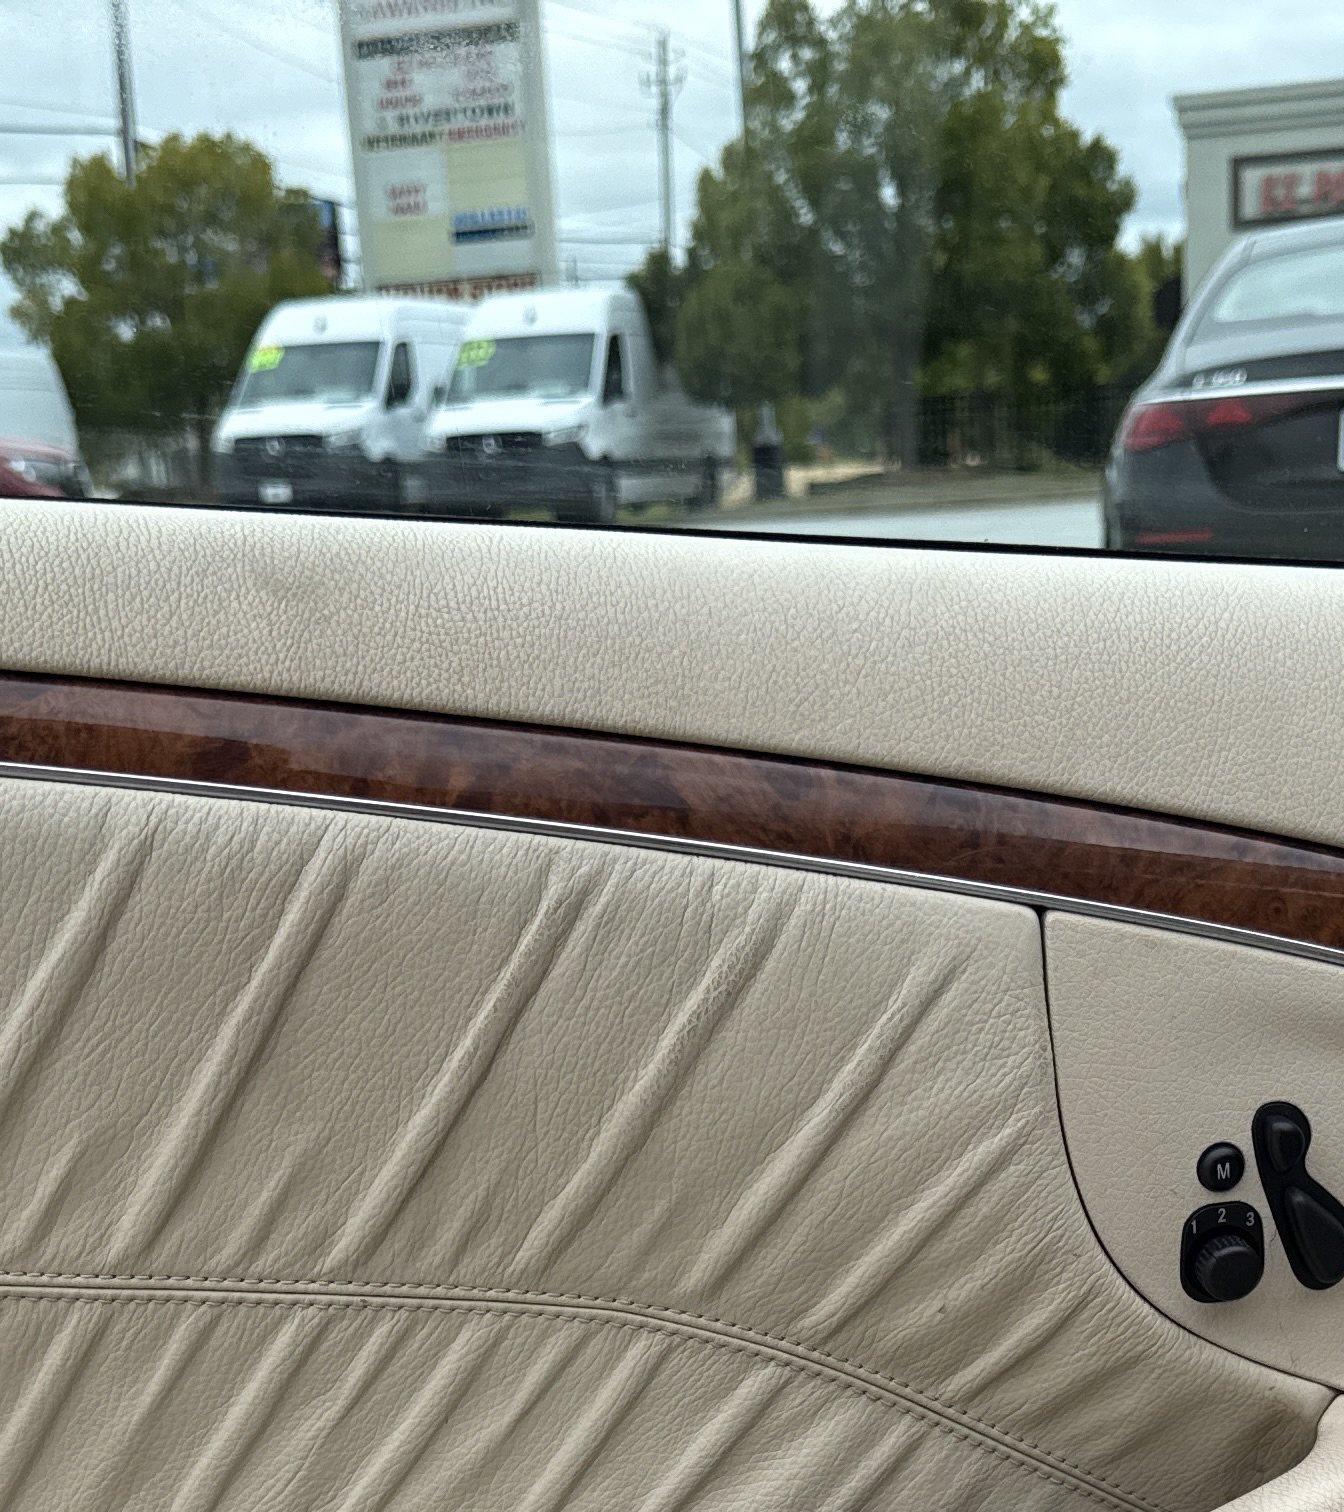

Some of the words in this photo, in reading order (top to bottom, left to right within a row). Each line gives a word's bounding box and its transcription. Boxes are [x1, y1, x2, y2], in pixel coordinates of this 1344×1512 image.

[1216, 1162, 1231, 1180] M
[1190, 1220, 1197, 1234] 1
[1217, 1208, 1227, 1223] 2
[1245, 1211, 1255, 1227] 3
